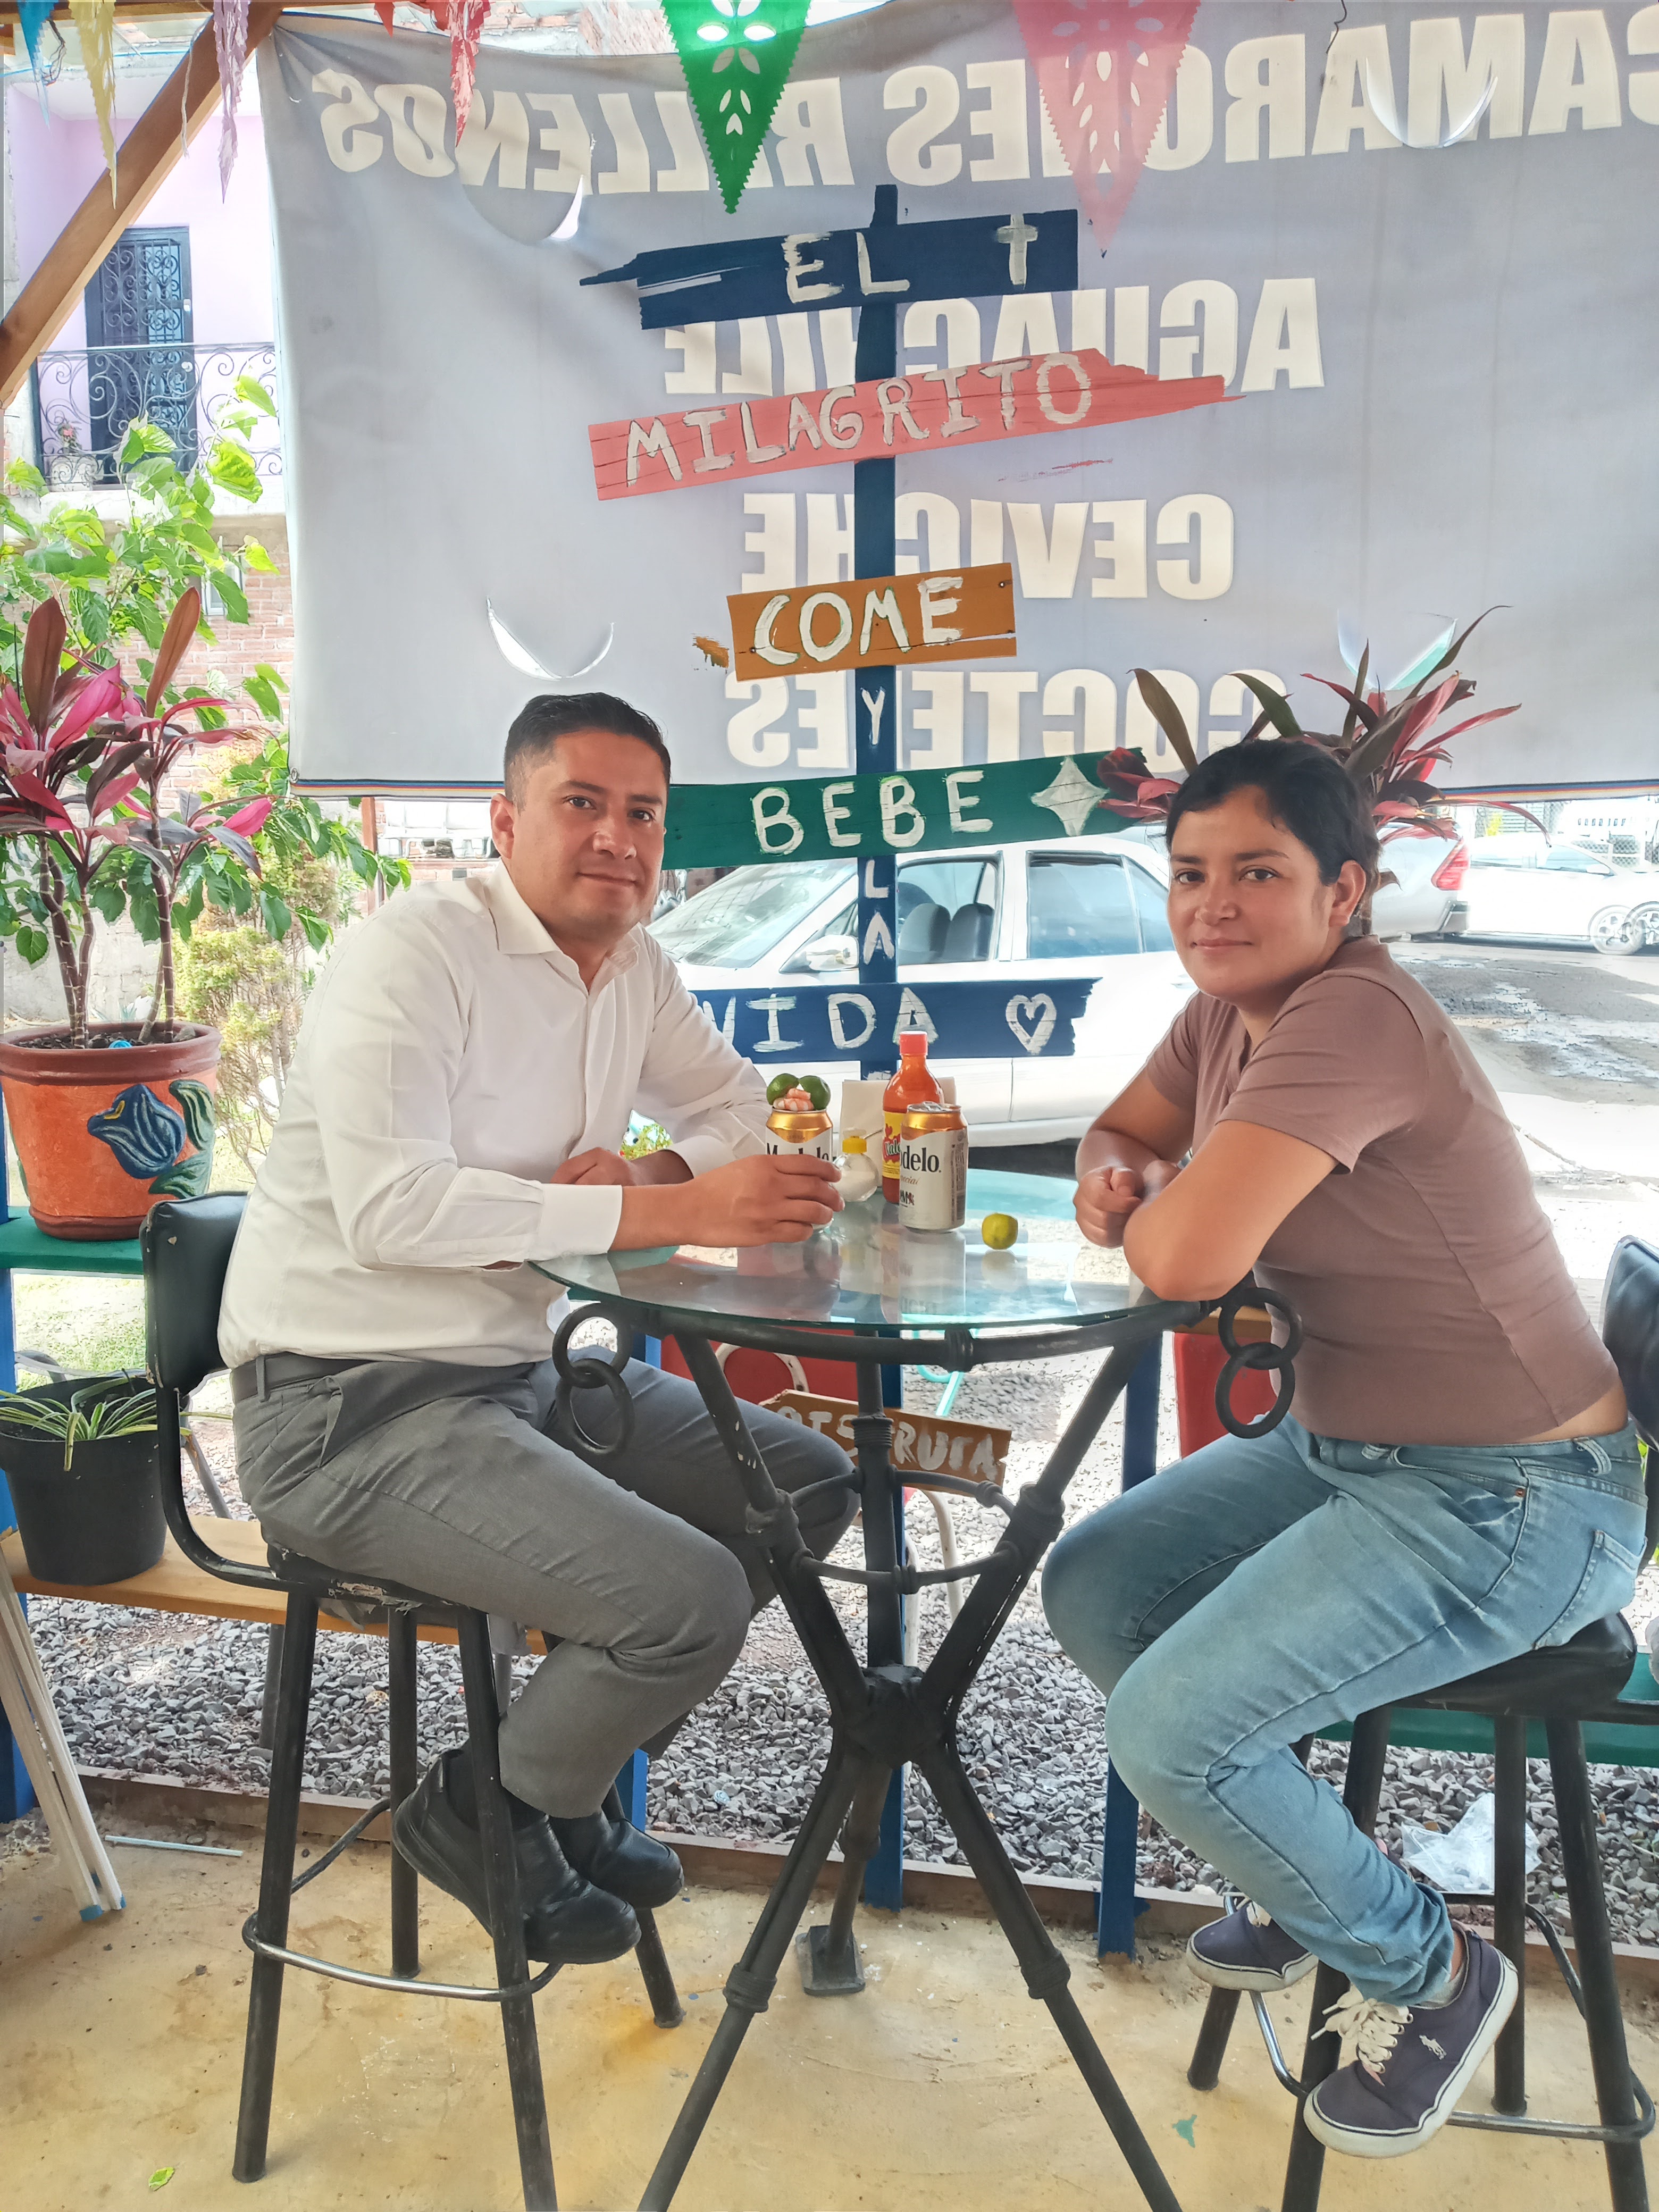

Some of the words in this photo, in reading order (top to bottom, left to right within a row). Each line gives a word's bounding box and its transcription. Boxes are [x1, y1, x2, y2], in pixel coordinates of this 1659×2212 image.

[781, 231, 910, 304] EL
[626, 352, 1092, 487] MILAGRITO
[753, 576, 963, 665] COME
[860, 686, 885, 745] Y
[751, 769, 993, 856] BEBE
[864, 859, 895, 966] LA
[702, 987, 939, 1053] VIDA
[900, 1145, 941, 1173] delo.
